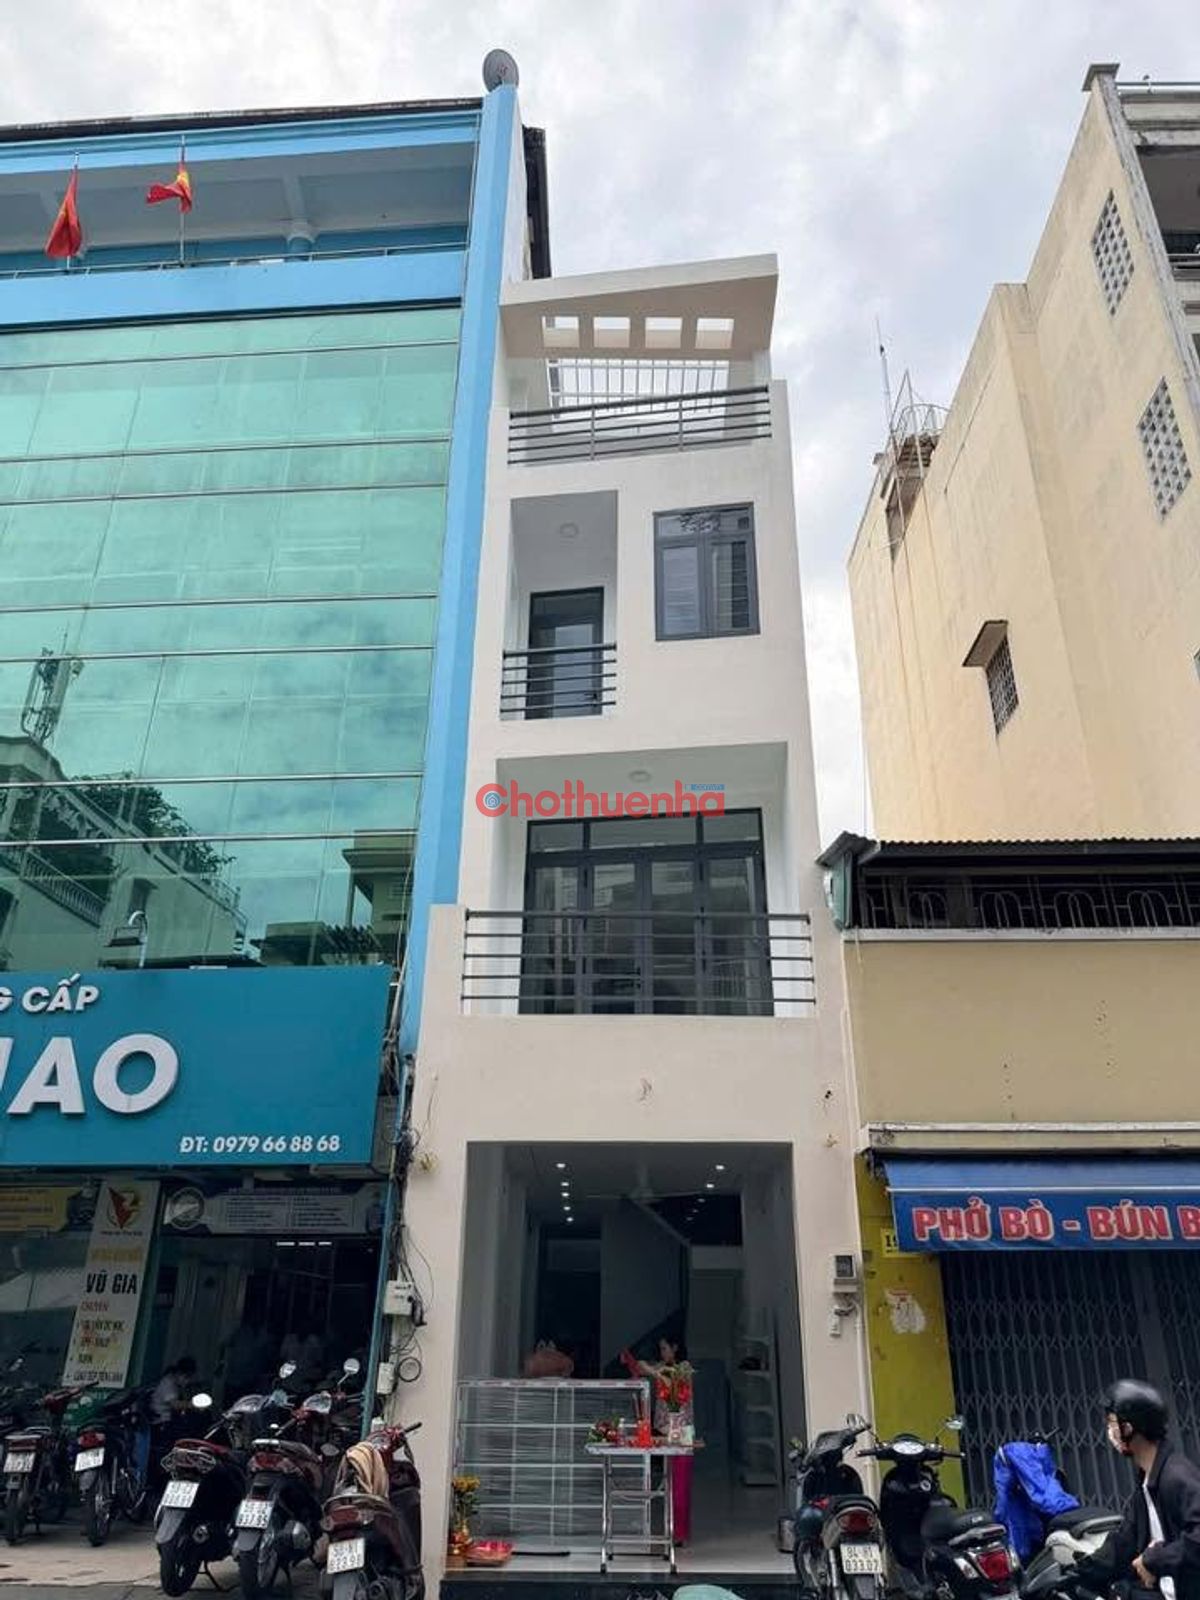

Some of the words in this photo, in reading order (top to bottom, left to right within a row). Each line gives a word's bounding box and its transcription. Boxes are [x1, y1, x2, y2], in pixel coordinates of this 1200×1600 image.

[22, 973, 99, 1012] CẤP
[179, 1137, 209, 1153] ĐT:
[212, 1136, 259, 1153] 0979
[262, 1136, 286, 1153] 66
[289, 1135, 314, 1152] 88
[316, 1135, 340, 1152] 68
[912, 1196, 992, 1240] PHỞ
[999, 1199, 1055, 1240] BÒ
[1086, 1199, 1173, 1240] BÚN
[112, 1273, 138, 1295] GIA
